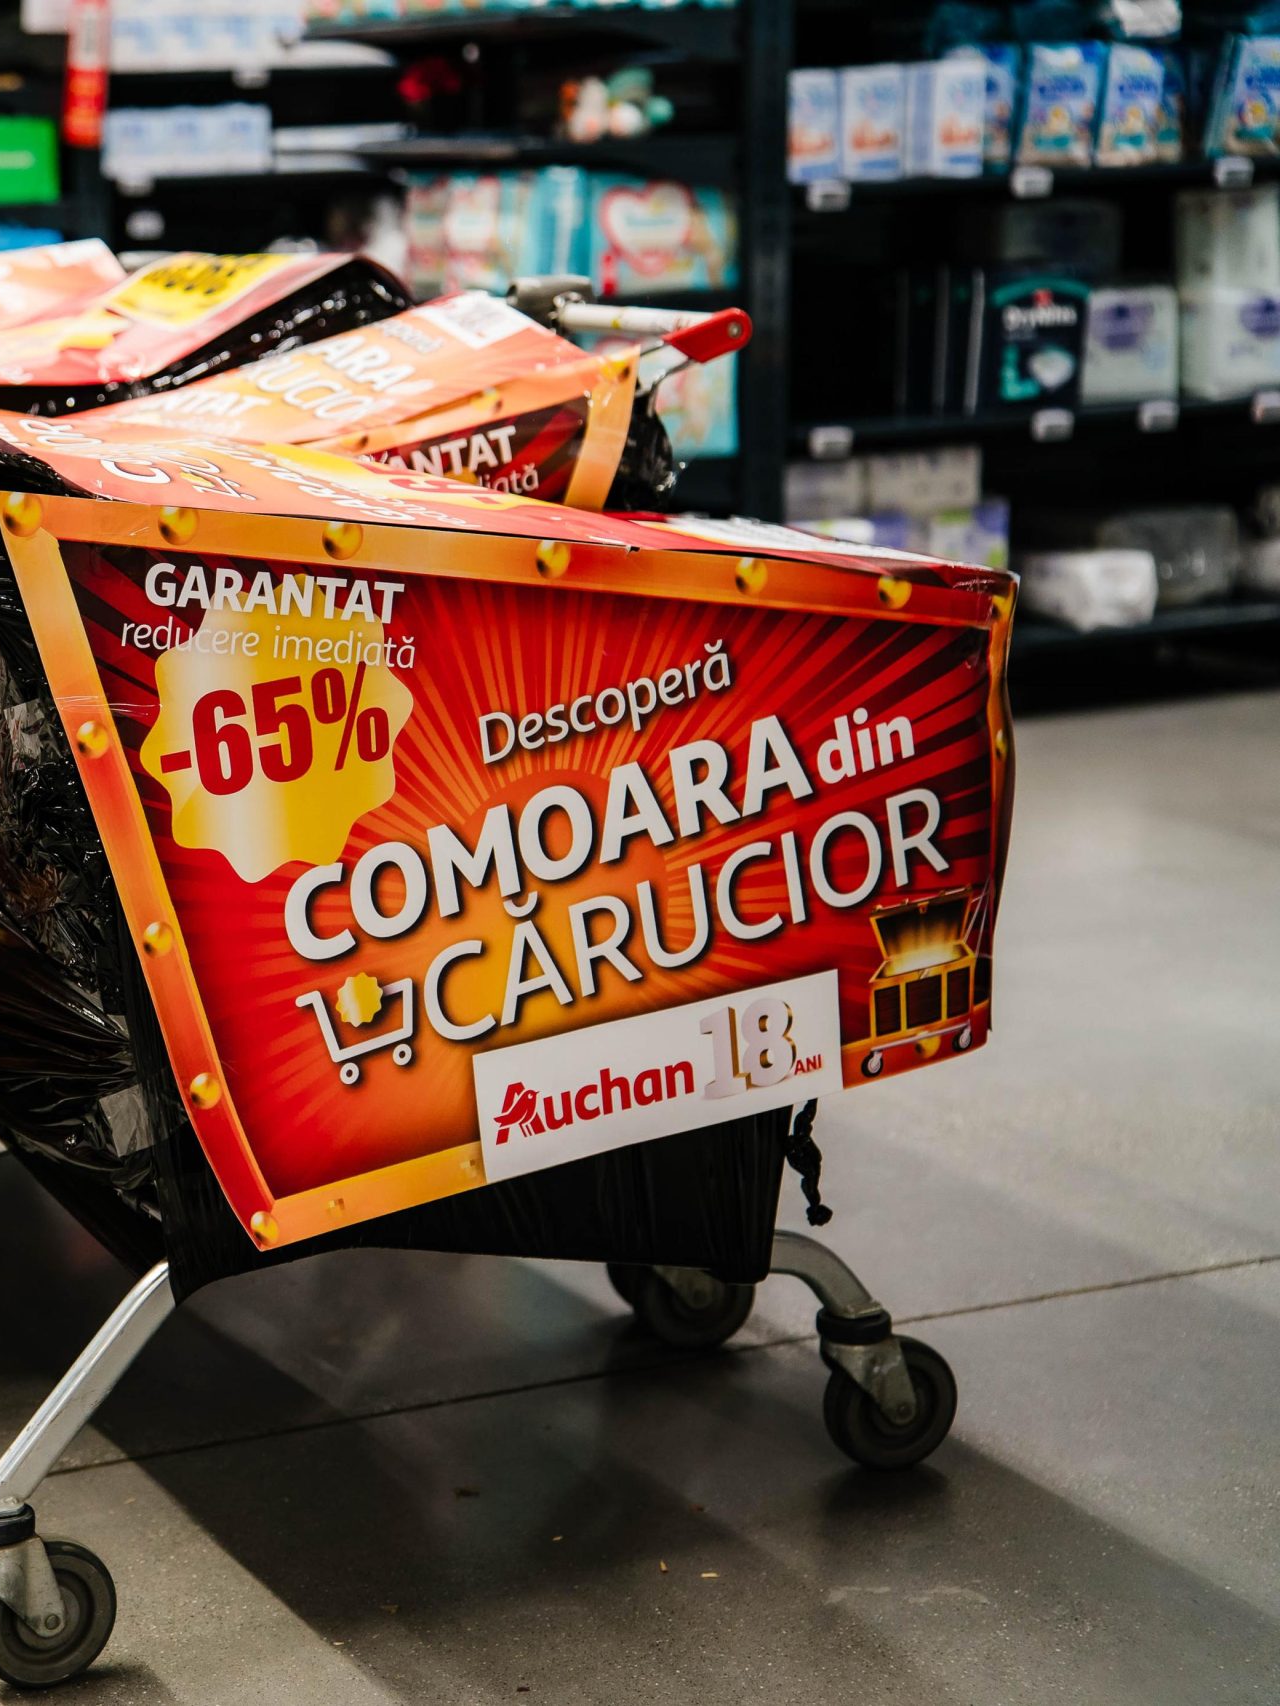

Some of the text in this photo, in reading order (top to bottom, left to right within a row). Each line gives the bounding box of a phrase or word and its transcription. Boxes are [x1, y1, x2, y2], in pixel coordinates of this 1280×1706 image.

[380, 425, 516, 477] ANTAT
[121, 616, 415, 669] reducere imediată
[145, 562, 405, 624] GARANTAT
[160, 660, 390, 796] -65%
[478, 639, 731, 764] Descoperă
[284, 708, 915, 960] COMOARA din
[423, 788, 949, 1041] CĂRUCIOR
[493, 999, 823, 1145] Auchan 18 ANI
